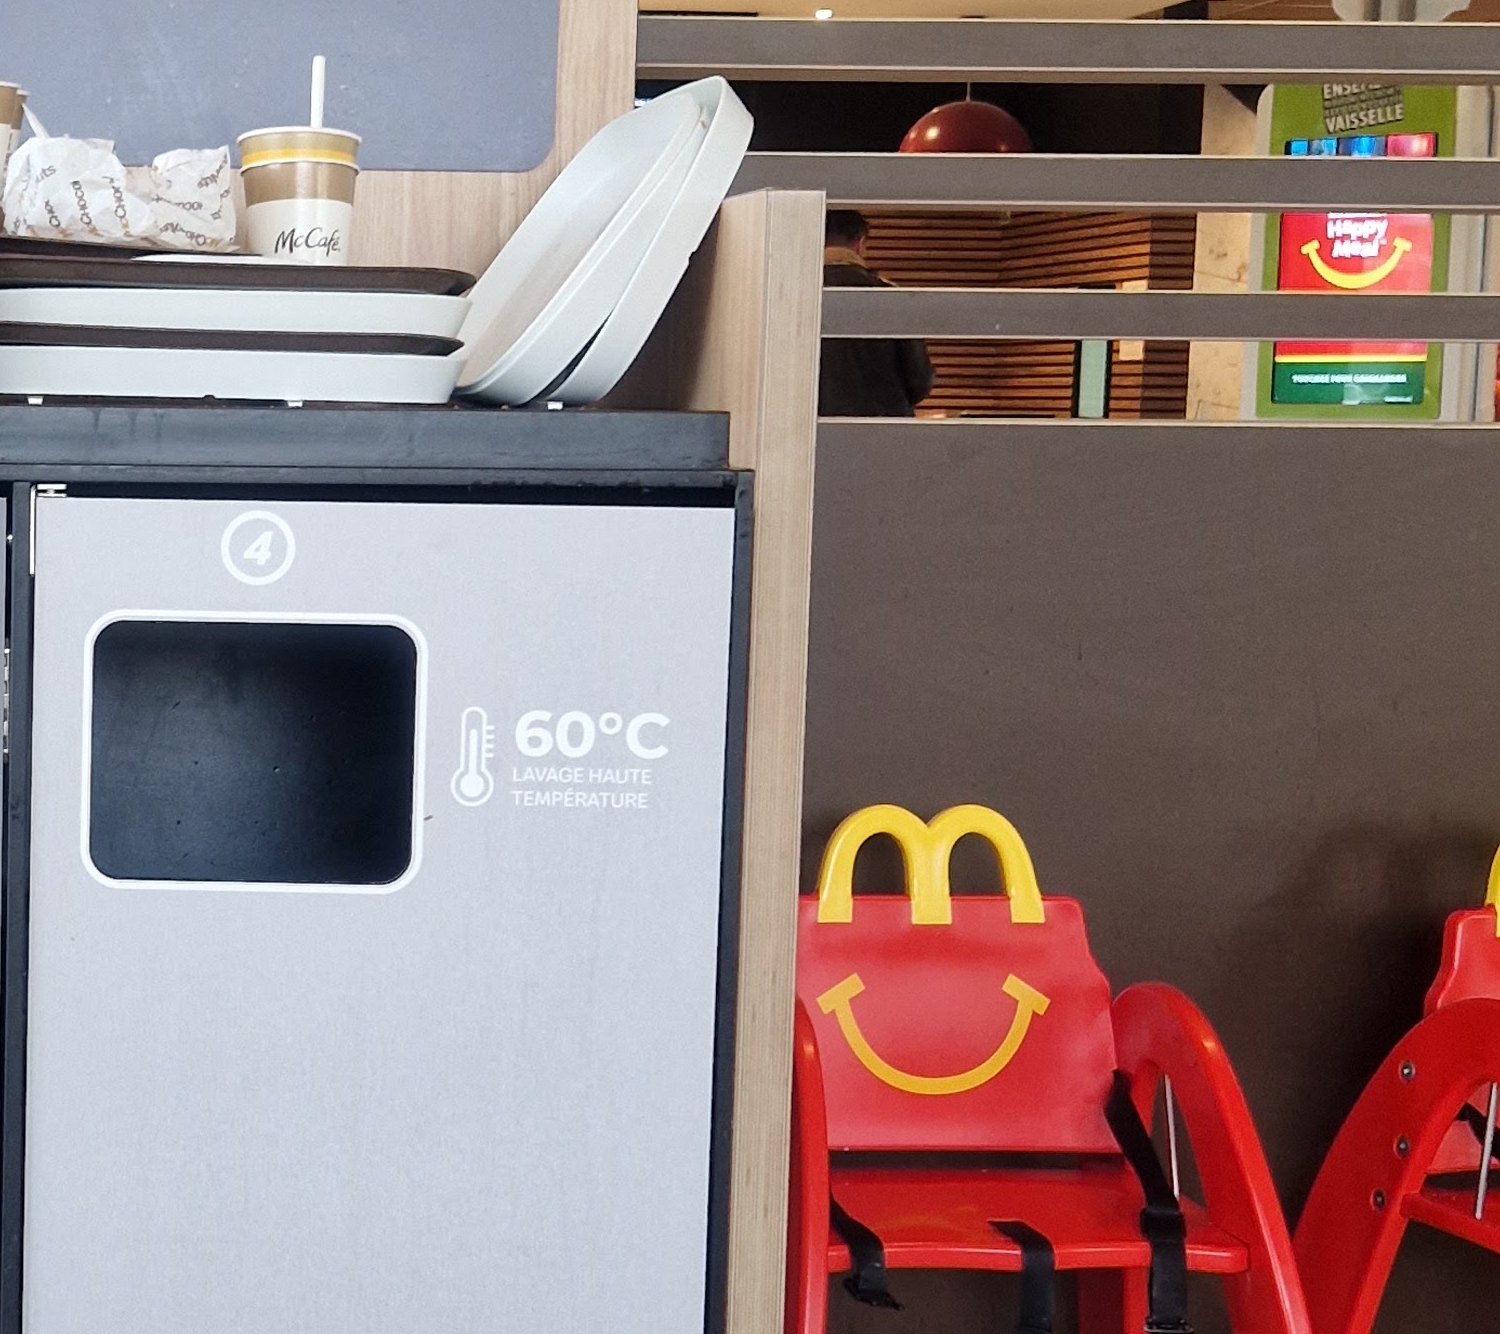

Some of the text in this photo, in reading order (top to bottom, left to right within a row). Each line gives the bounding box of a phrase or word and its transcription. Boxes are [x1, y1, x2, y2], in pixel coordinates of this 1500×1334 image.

[1326, 103, 1404, 133] VAISSELLE
[274, 227, 340, 257] McCafé
[243, 531, 273, 565] 4
[515, 710, 670, 759] 60°C
[513, 767, 652, 784] LAVAGE HAUTE
[513, 788, 648, 808] TEMPÉRATURE
